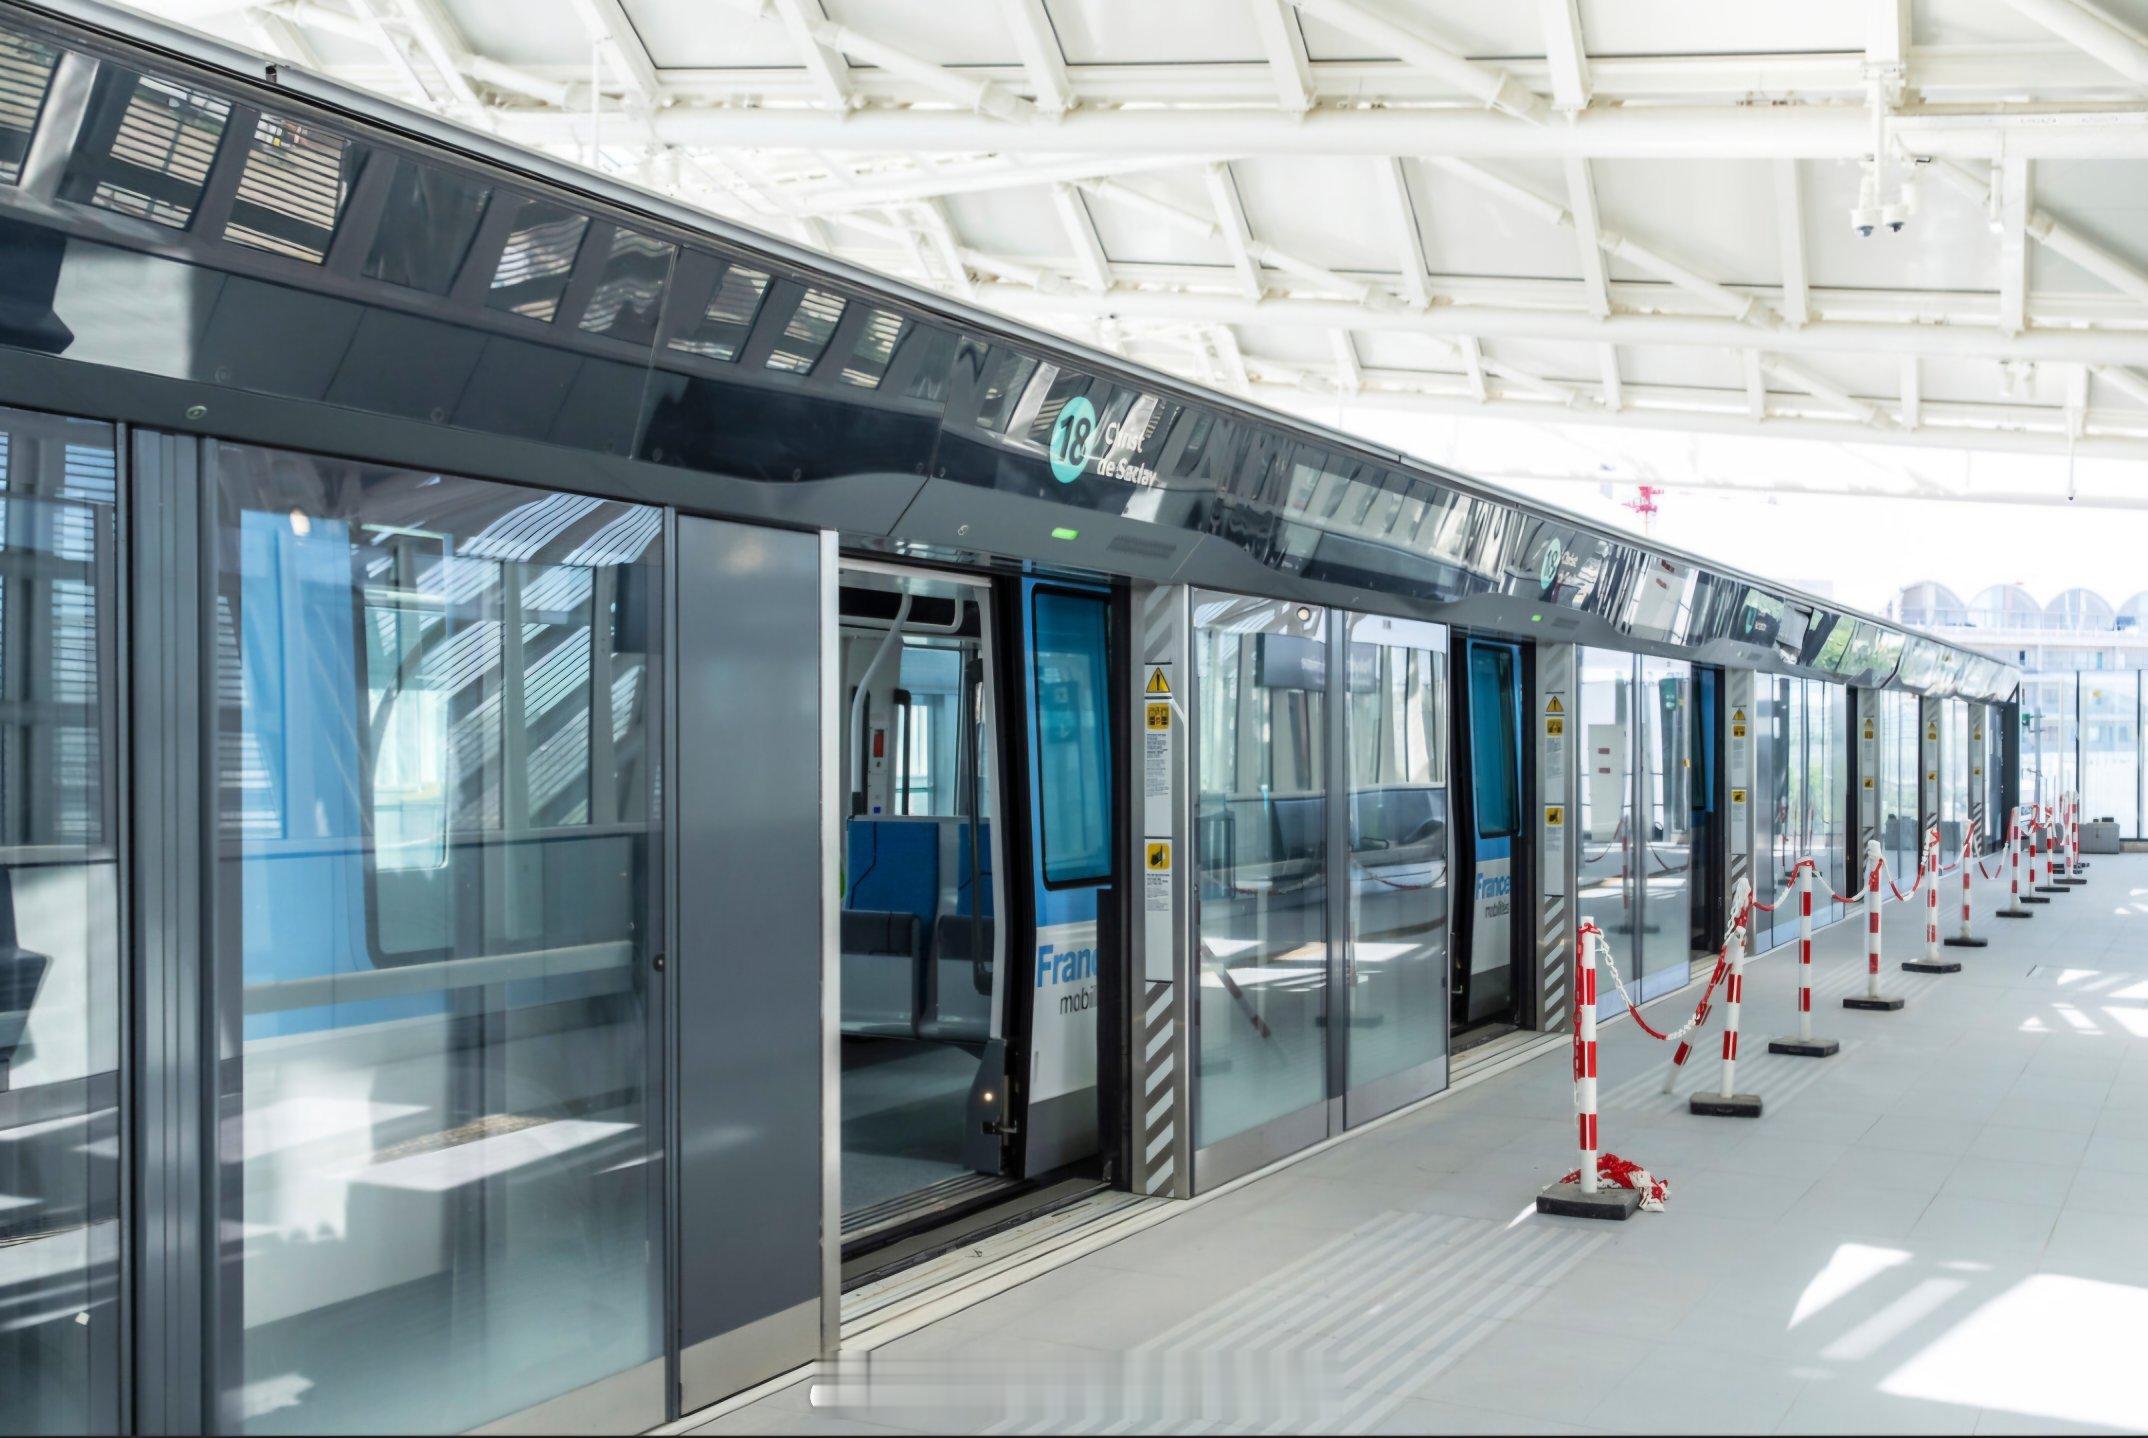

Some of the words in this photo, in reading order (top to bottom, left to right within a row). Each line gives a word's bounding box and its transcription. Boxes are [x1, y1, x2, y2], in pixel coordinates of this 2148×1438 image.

[1059, 414, 1092, 467] 18
[1097, 456, 1116, 477] de
[1116, 457, 1158, 489] Saclay
